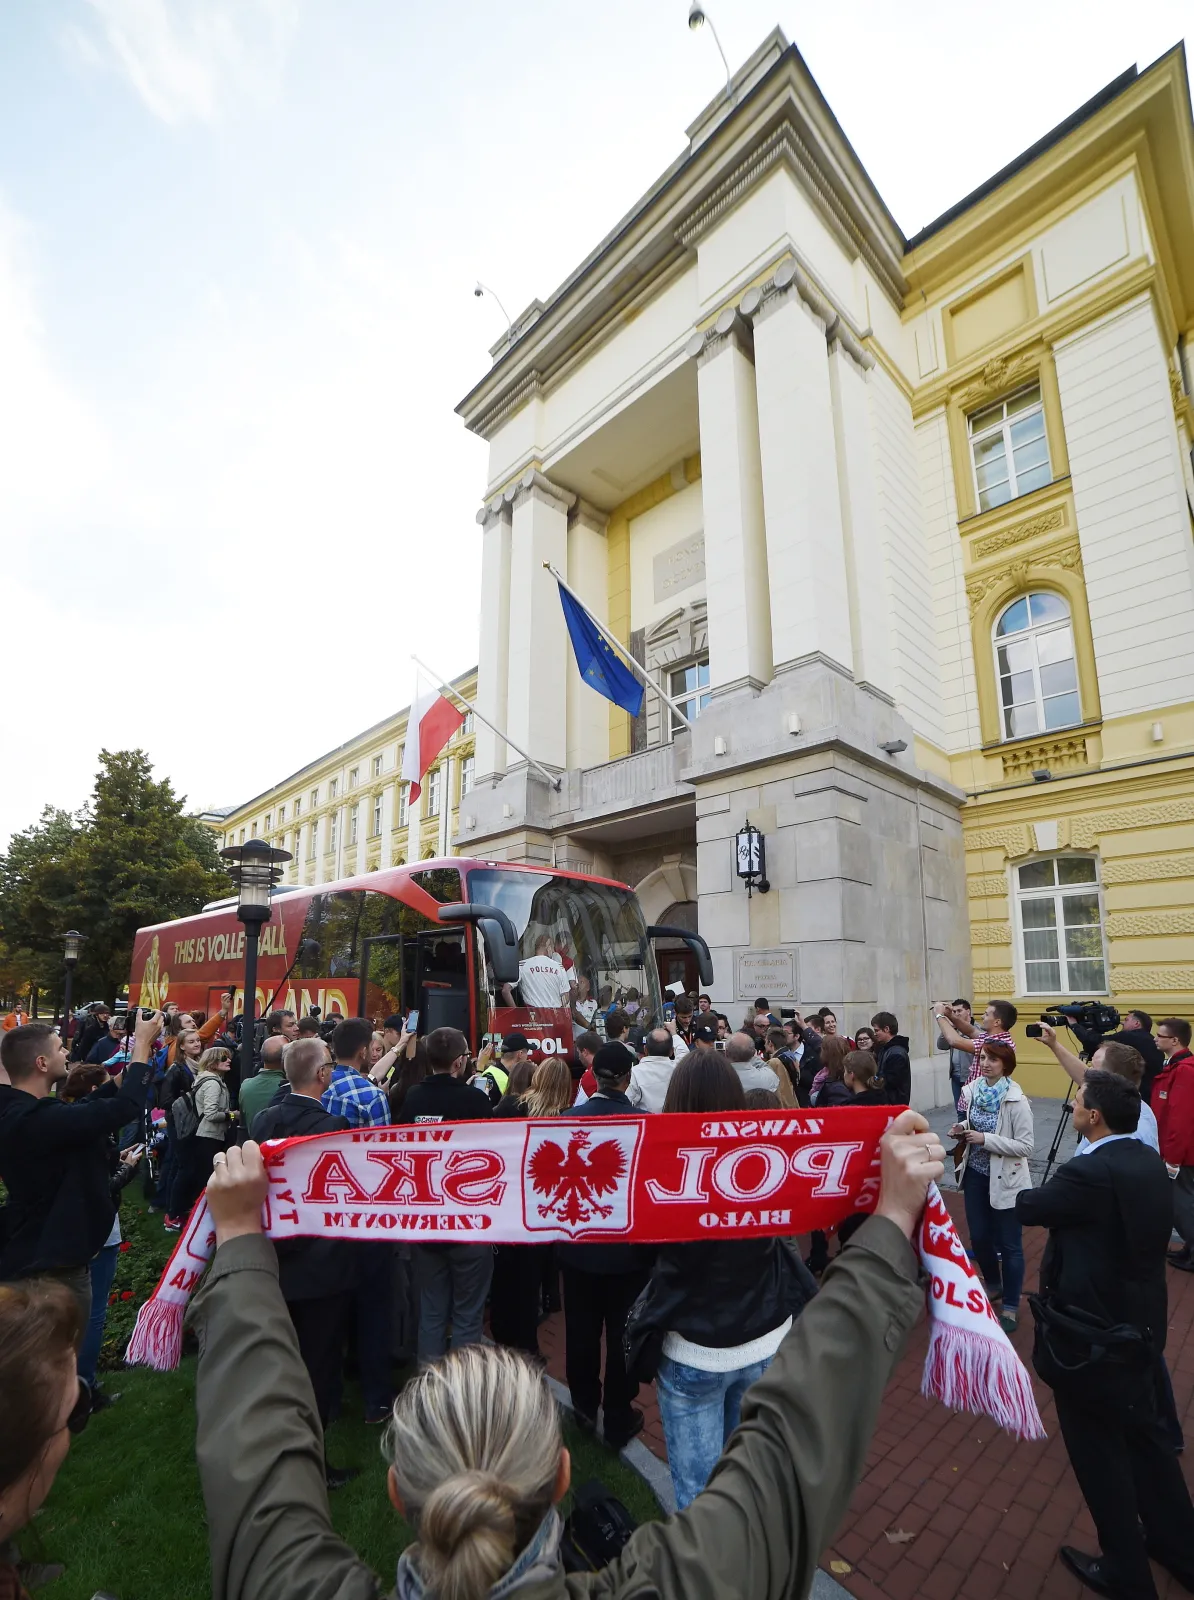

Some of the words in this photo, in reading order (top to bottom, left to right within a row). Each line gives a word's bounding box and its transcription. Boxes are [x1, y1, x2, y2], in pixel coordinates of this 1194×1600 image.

[174, 939, 196, 964] THIS
[195, 936, 207, 962] IS
[207, 924, 287, 961] VOLLEALL
[529, 965, 559, 975] POLSKA
